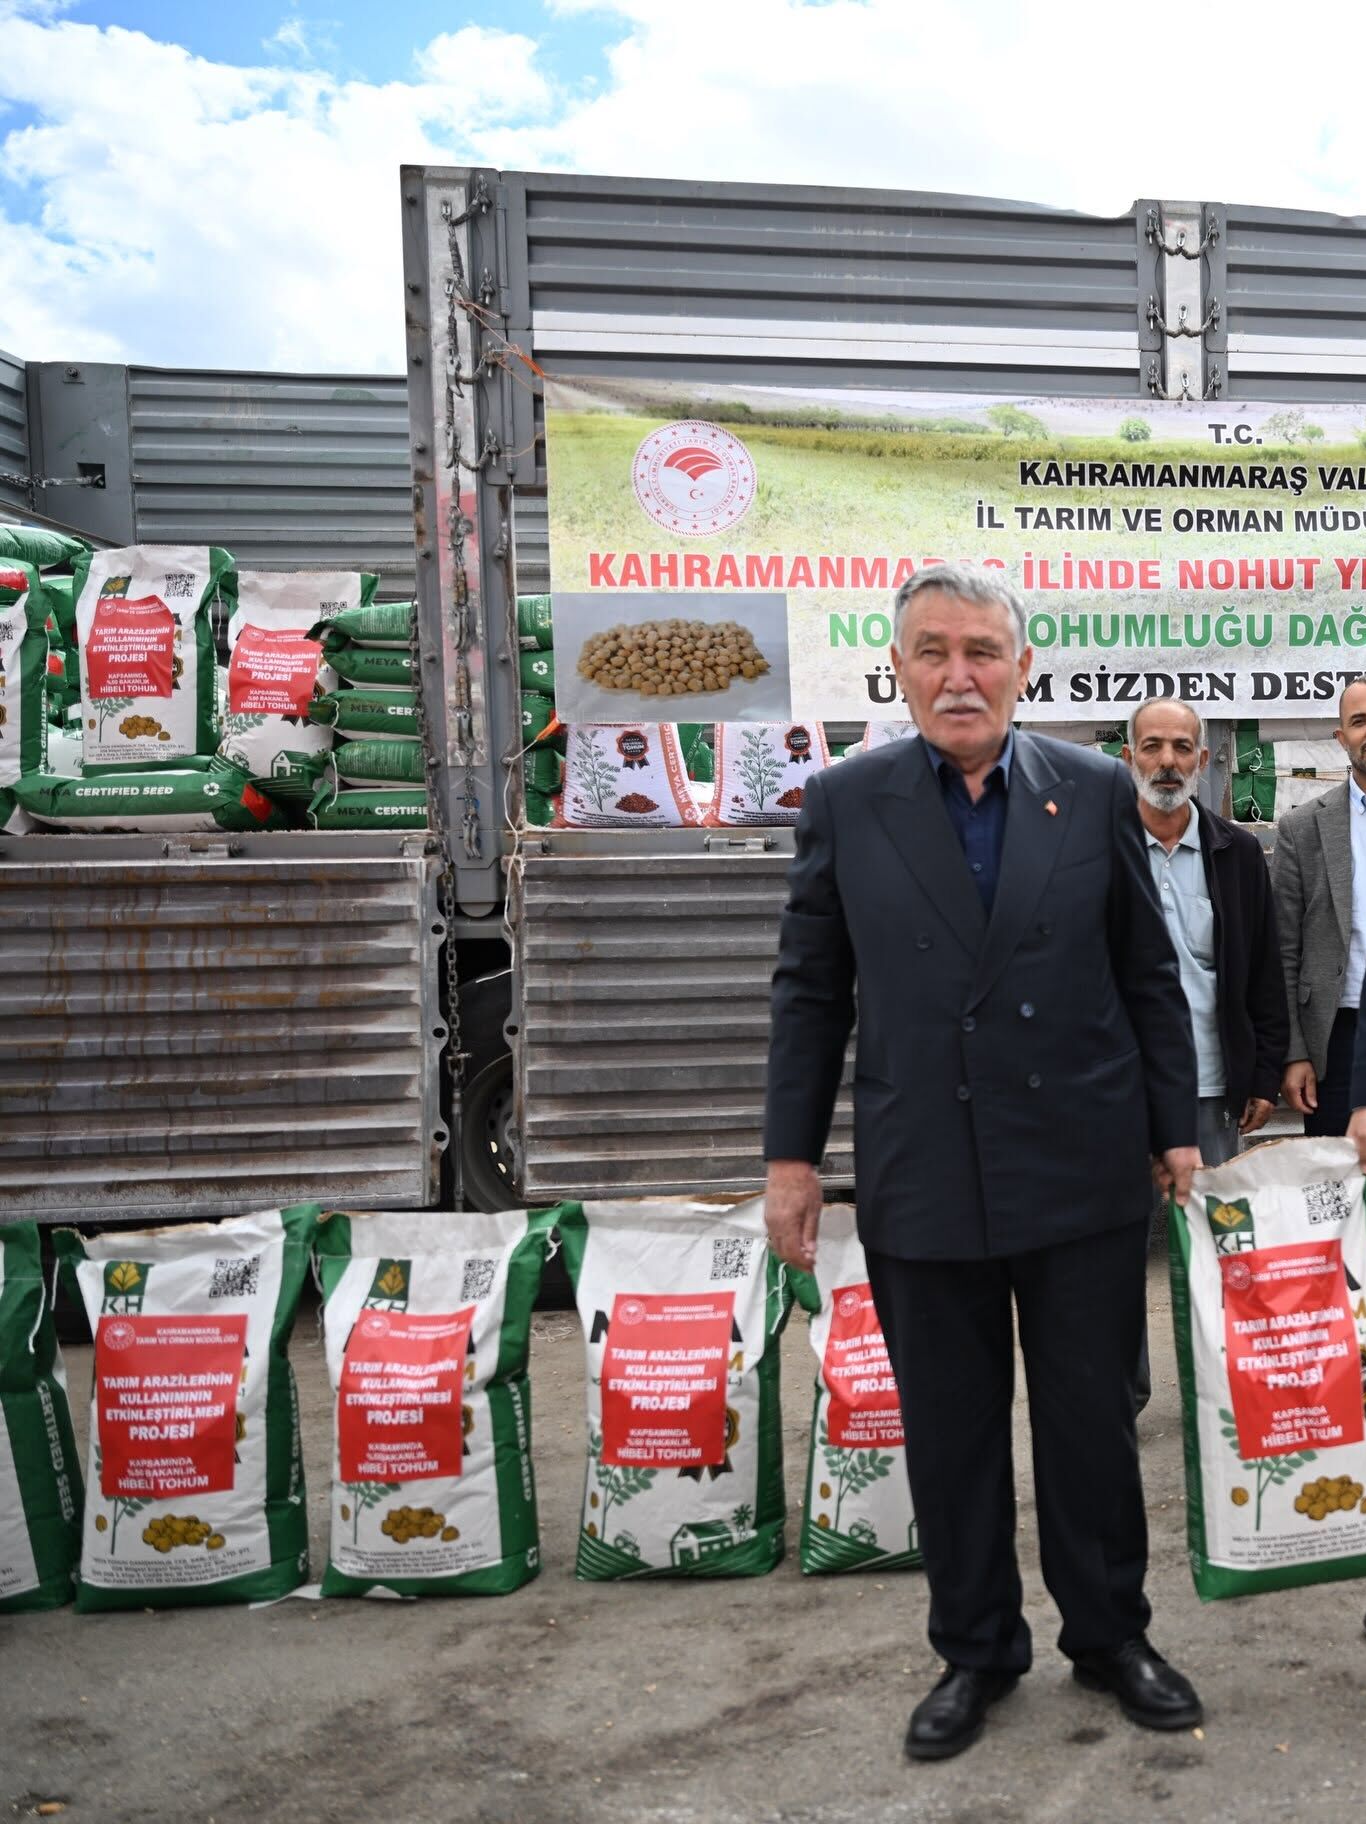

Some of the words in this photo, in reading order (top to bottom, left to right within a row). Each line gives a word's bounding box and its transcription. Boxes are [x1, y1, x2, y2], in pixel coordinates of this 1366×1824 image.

[1209, 424, 1263, 446] T.C.
[1020, 461, 1308, 497] KAHRAMANMARAŞ
[977, 506, 1003, 530] İL
[1015, 509, 1114, 531] TARIM
[1120, 509, 1161, 531] VE
[1172, 509, 1282, 532] ORMAN
[590, 553, 1005, 589] KAHRAMANMA
[1023, 552, 1160, 590] İLİNDE
[1178, 557, 1320, 591] NOHUT
[1028, 605, 1272, 648] OHUMLUĞU
[109, 652, 147, 662] PROJESİ
[365, 658, 399, 666] MEYA
[1070, 664, 1236, 701] SİZDEN
[241, 701, 265, 709] HİBELİ
[267, 702, 297, 710] TOHUM
[76, 787, 139, 797] CERTIFIED
[143, 787, 173, 795] SEED
[338, 807, 372, 815] MEYA
[375, 807, 428, 815] CERTIFIE
[103, 1376, 139, 1388] TARIM
[143, 1373, 233, 1388] ARAZİLERİNİN
[852, 1377, 896, 1393] PROJE
[631, 1395, 691, 1410] PROJESİ
[367, 1408, 424, 1424] PROJESİ
[130, 1423, 195, 1439] PROJESİ
[841, 1429, 877, 1441] HİBELİ
[880, 1428, 904, 1439] TOH
[1261, 1431, 1308, 1448] HİBELİ
[37, 1380, 64, 1472] CERTIFIED
[56, 1473, 75, 1522] SEED
[618, 1447, 654, 1458] HİBELİ
[657, 1447, 701, 1458] TOHUM
[391, 1461, 438, 1473] TOHUM
[118, 1478, 154, 1490] HİBELİ
[158, 1476, 209, 1490] TOHUM
